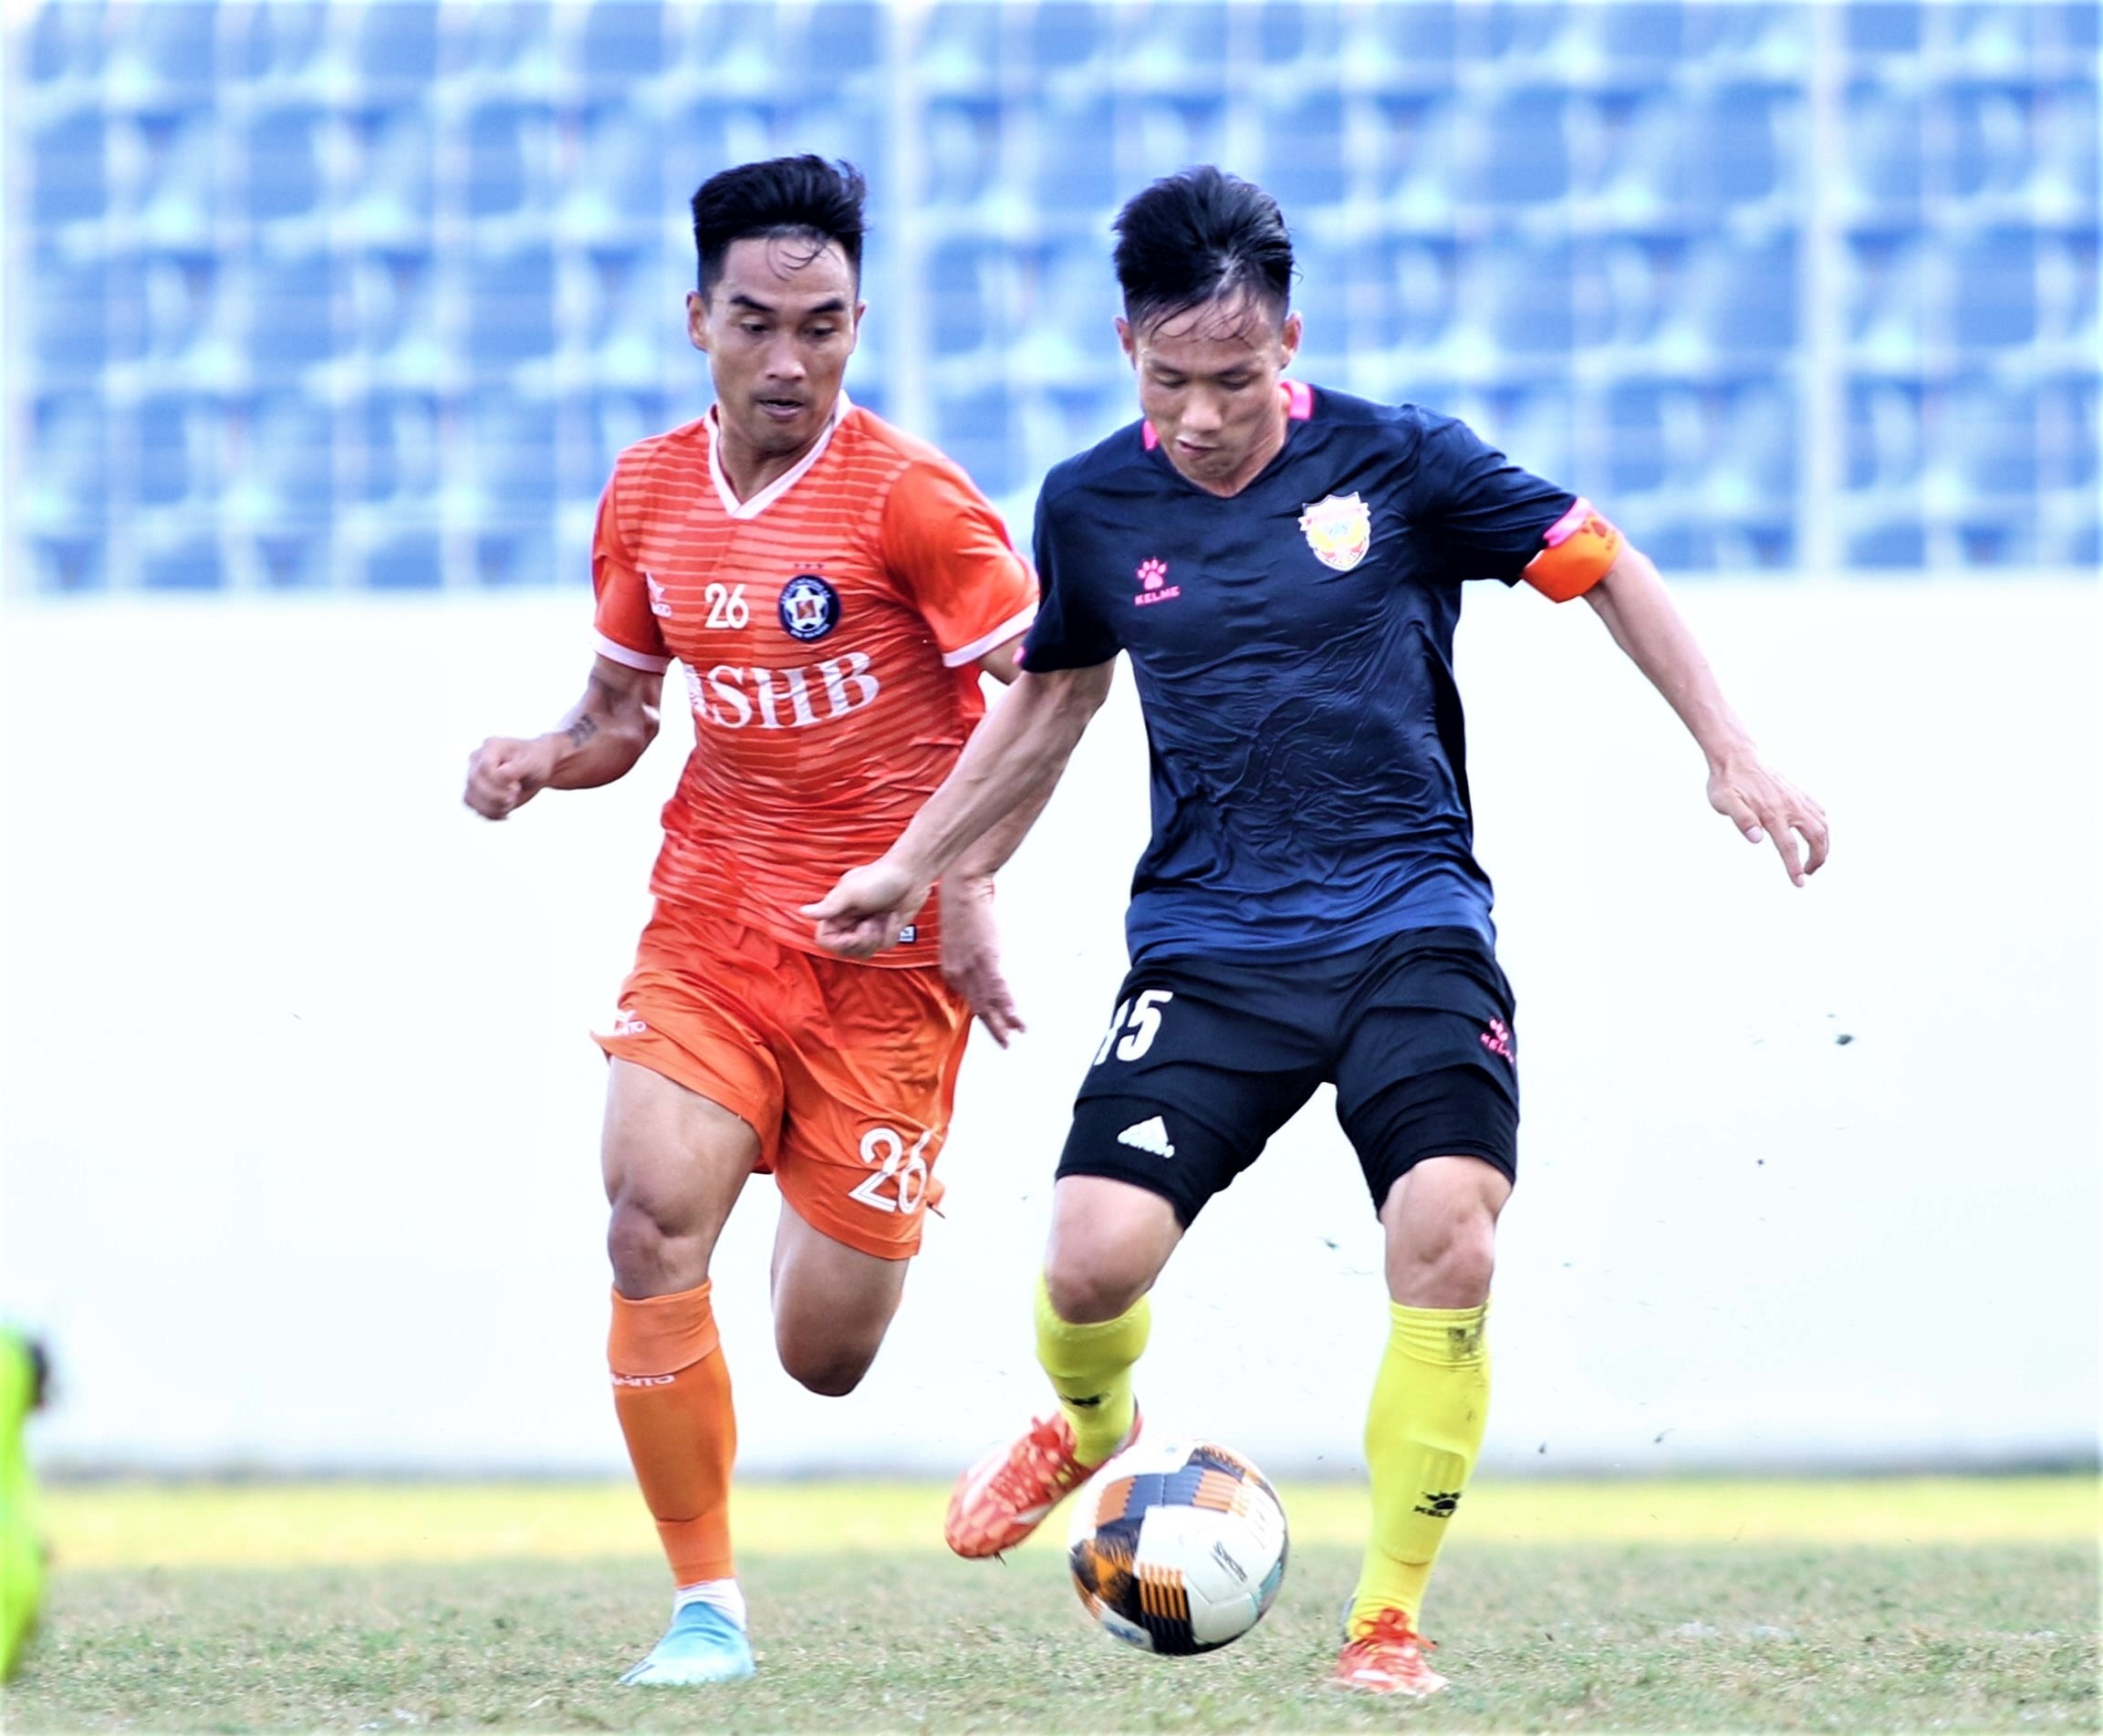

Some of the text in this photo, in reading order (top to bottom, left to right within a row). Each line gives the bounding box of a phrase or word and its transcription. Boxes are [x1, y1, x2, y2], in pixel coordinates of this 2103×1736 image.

[703, 583, 750, 629] 26
[1134, 586, 1181, 606] KELME
[847, 1127, 932, 1215] 26
